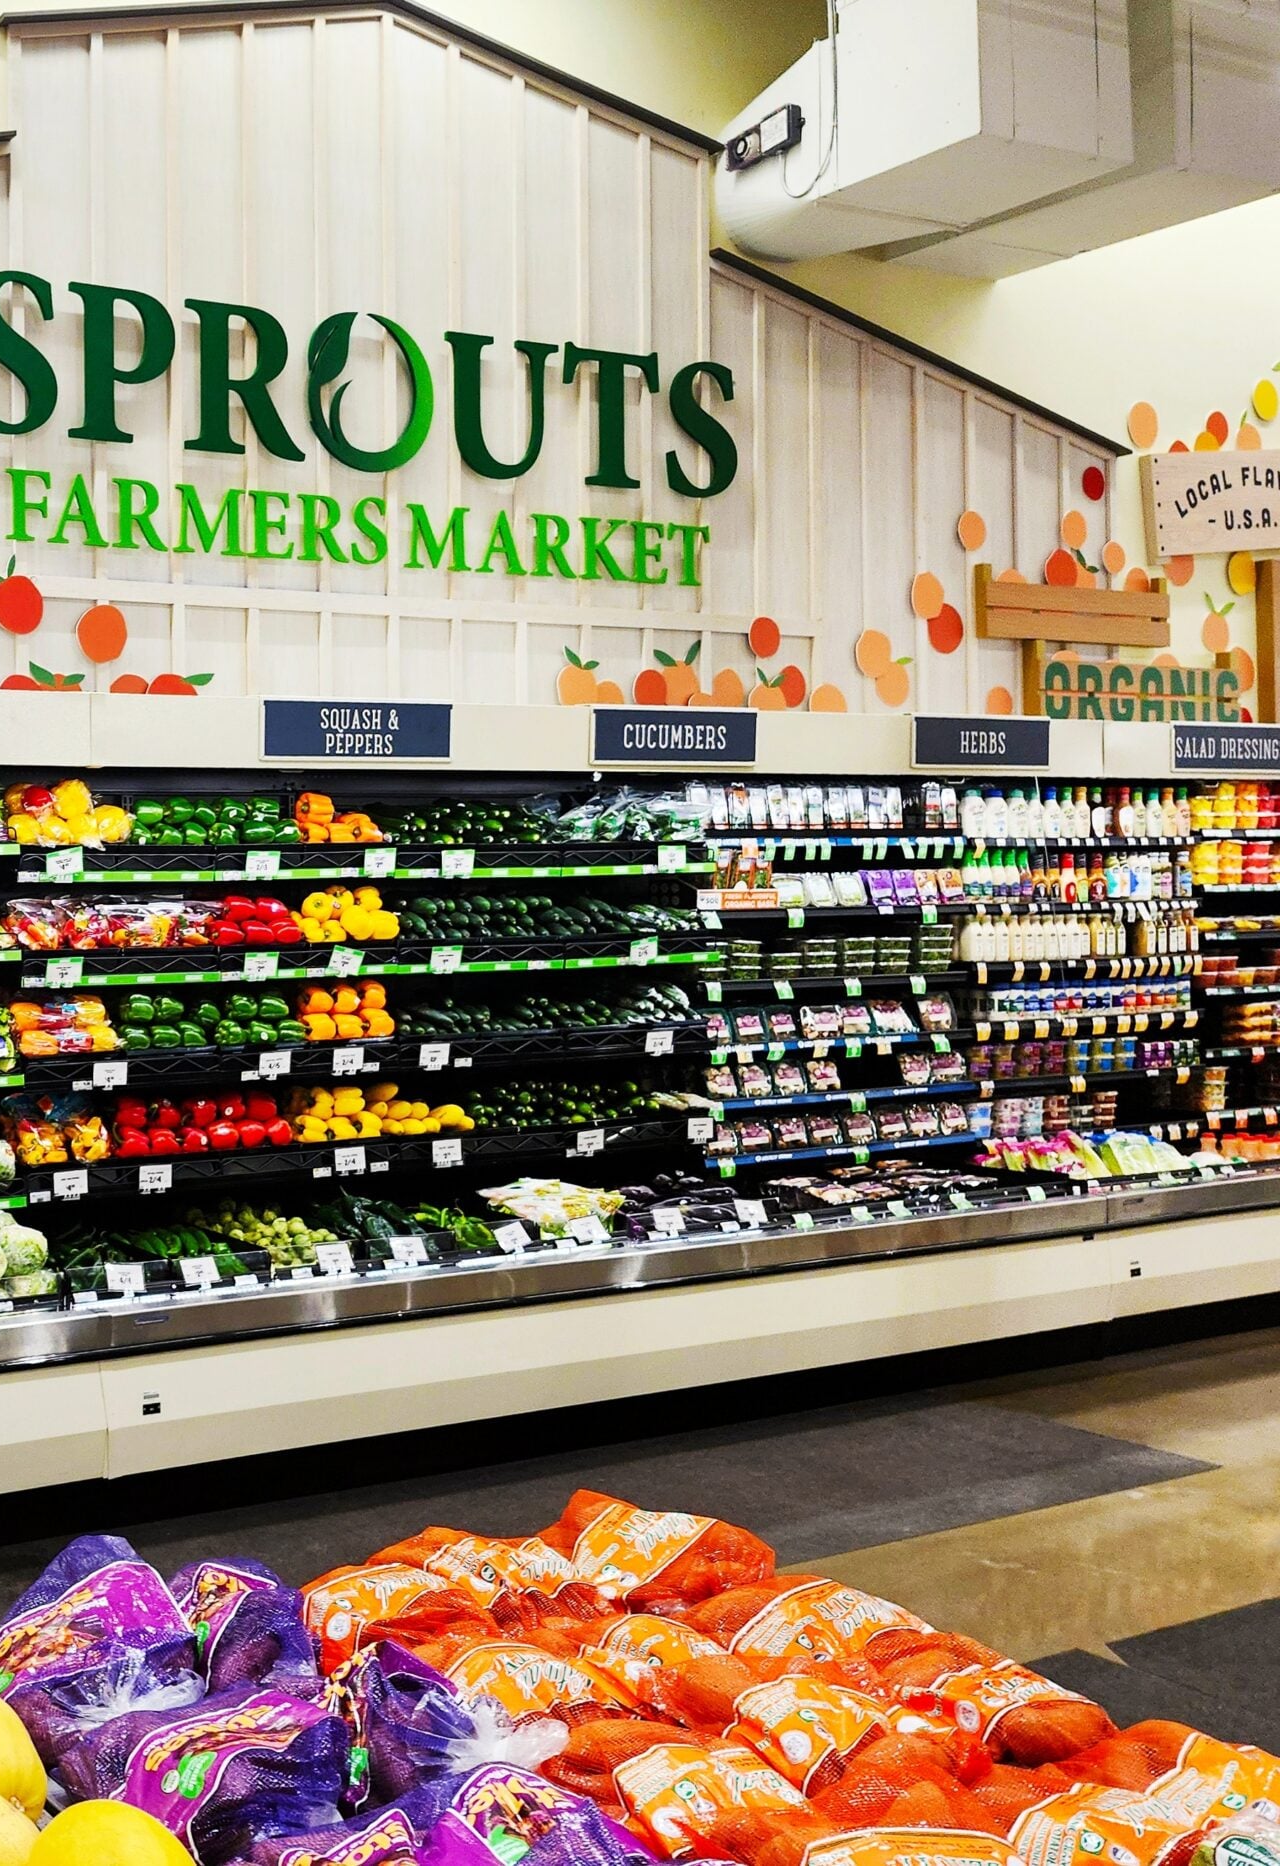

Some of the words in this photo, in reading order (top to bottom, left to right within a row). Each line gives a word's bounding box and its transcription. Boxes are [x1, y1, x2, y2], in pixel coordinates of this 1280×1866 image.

[1175, 469, 1232, 518] LOCAL
[4, 466, 388, 565] FARMERS
[405, 502, 710, 587] MARKET
[1045, 661, 1240, 722] ORGANIC
[320, 707, 381, 732] SQUASH
[388, 709, 400, 731] &
[325, 731, 394, 756] PEPPERS
[622, 724, 727, 751] CUCUMBERS
[959, 730, 1006, 754] HERBS
[1175, 737, 1216, 759] SALAD
